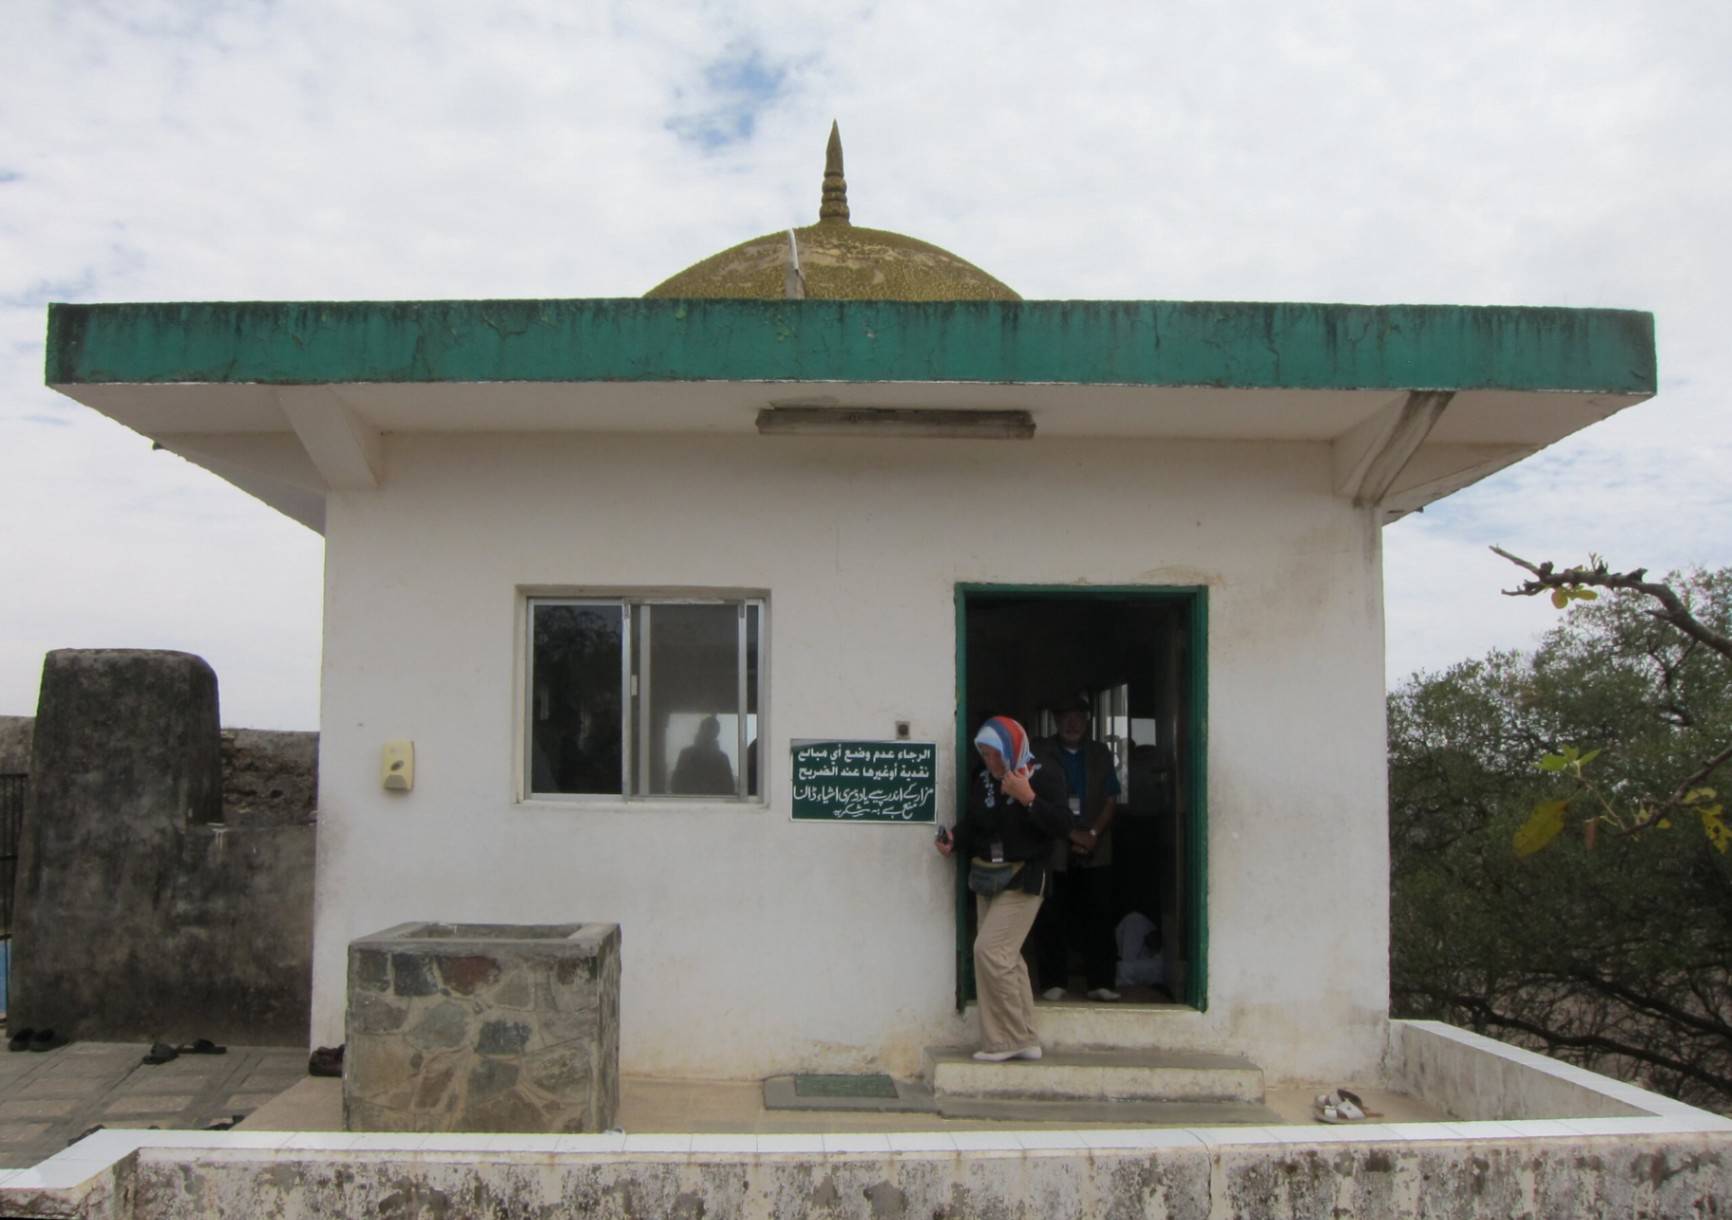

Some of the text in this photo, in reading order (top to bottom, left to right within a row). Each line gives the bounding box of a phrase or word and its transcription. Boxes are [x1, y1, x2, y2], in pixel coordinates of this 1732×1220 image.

[830, 744, 841, 765] أي
[844, 747, 871, 762] وضع
[873, 750, 895, 763] عدم
[898, 749, 930, 762] الرجاء
[798, 765, 838, 780] الضريح
[840, 766, 860, 776] عند
[900, 764, 929, 781] نقدية
